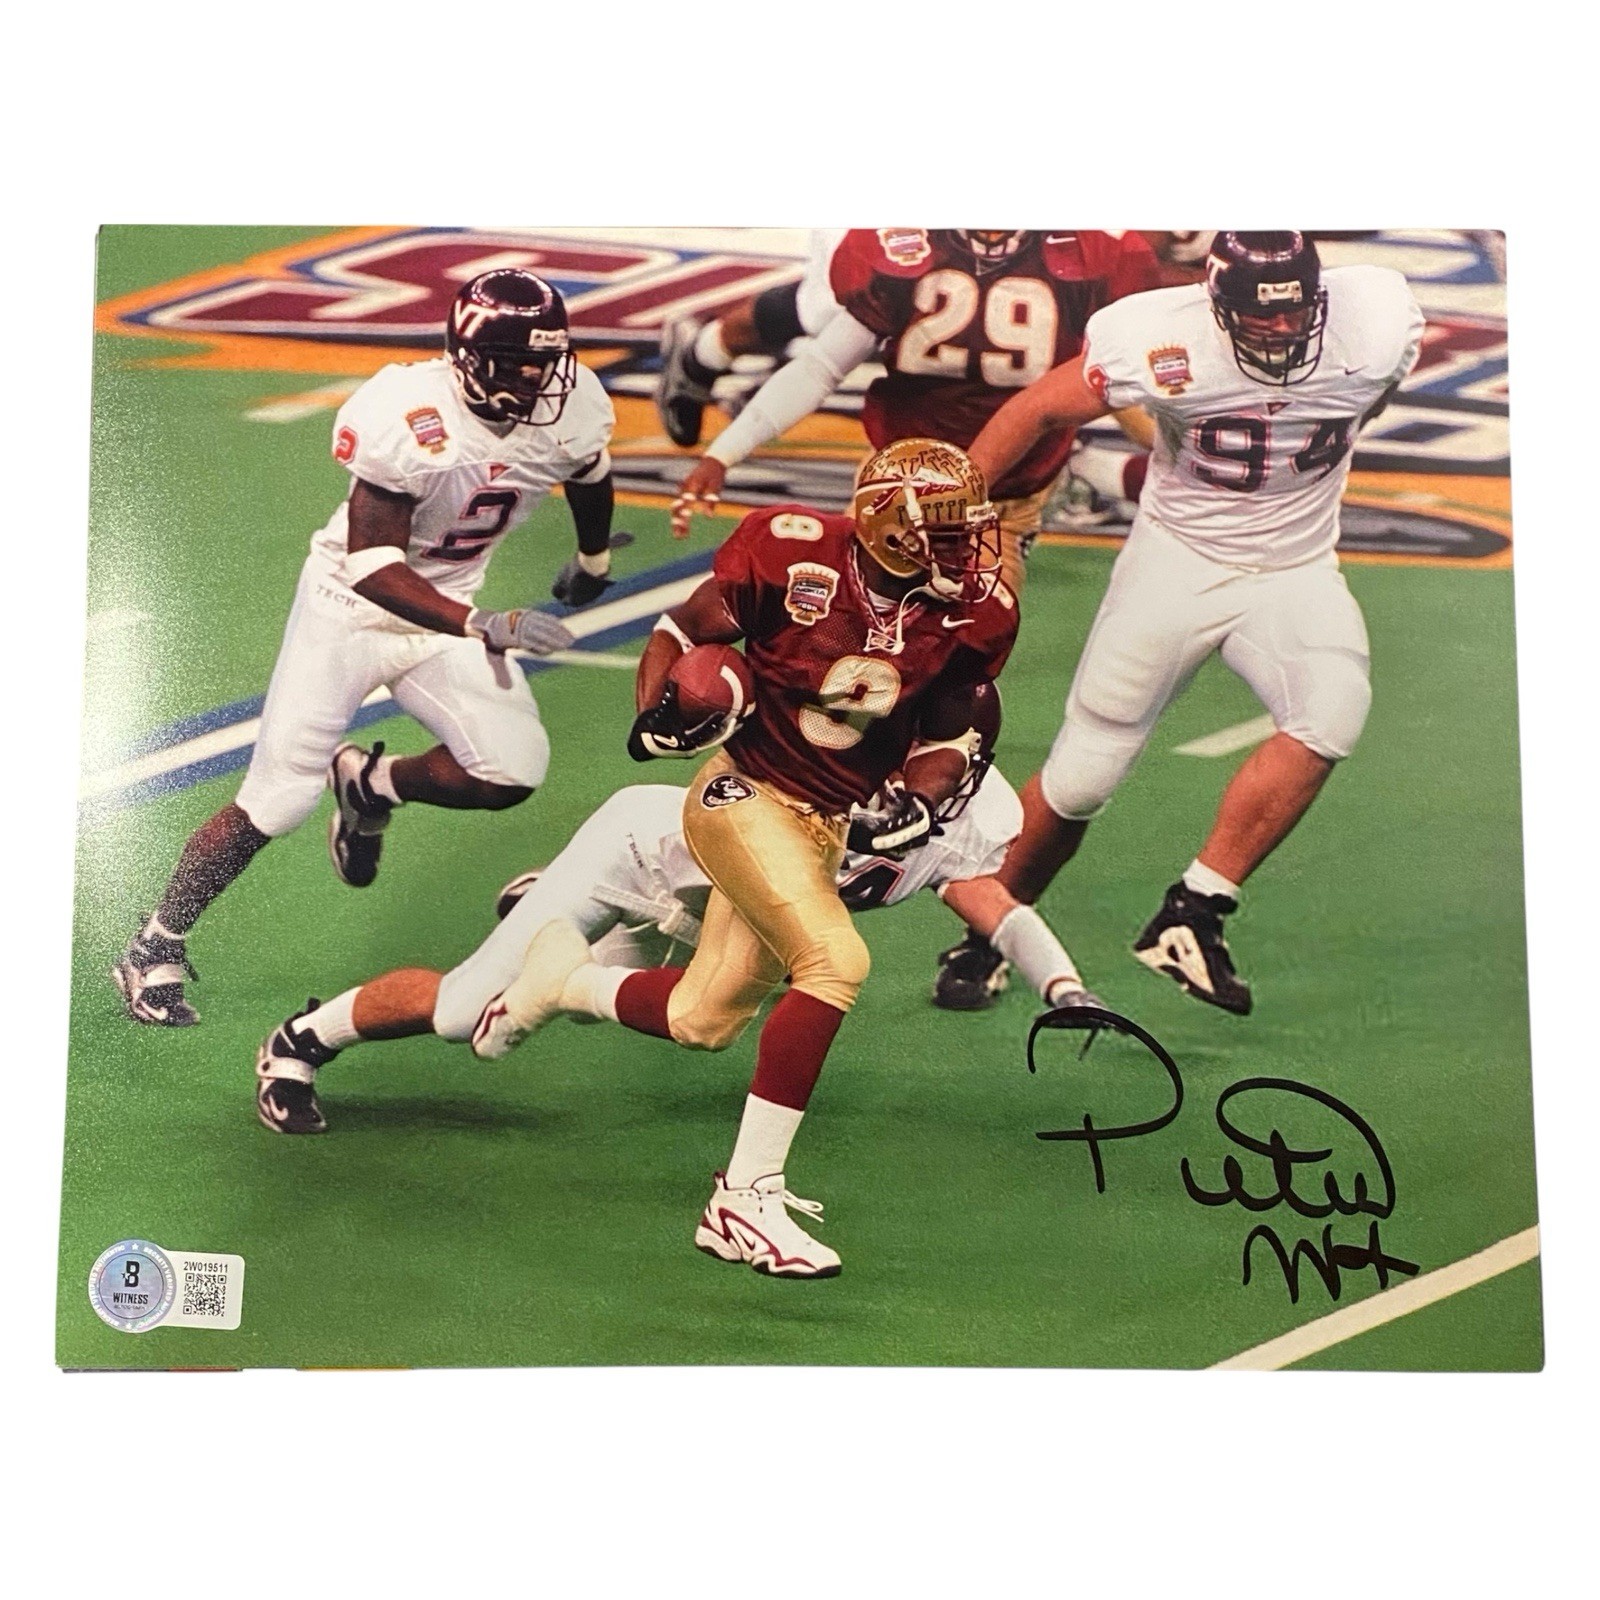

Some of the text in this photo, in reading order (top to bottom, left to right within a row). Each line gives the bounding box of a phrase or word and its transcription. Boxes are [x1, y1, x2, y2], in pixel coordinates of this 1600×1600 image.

[455, 299, 500, 339] VT
[897, 268, 1058, 387] 29
[333, 426, 359, 465] 2
[1190, 411, 1352, 493] 94
[420, 486, 521, 565] 2
[183, 1261, 228, 1273] 2W019511
[113, 1292, 149, 1305] WITNESS
